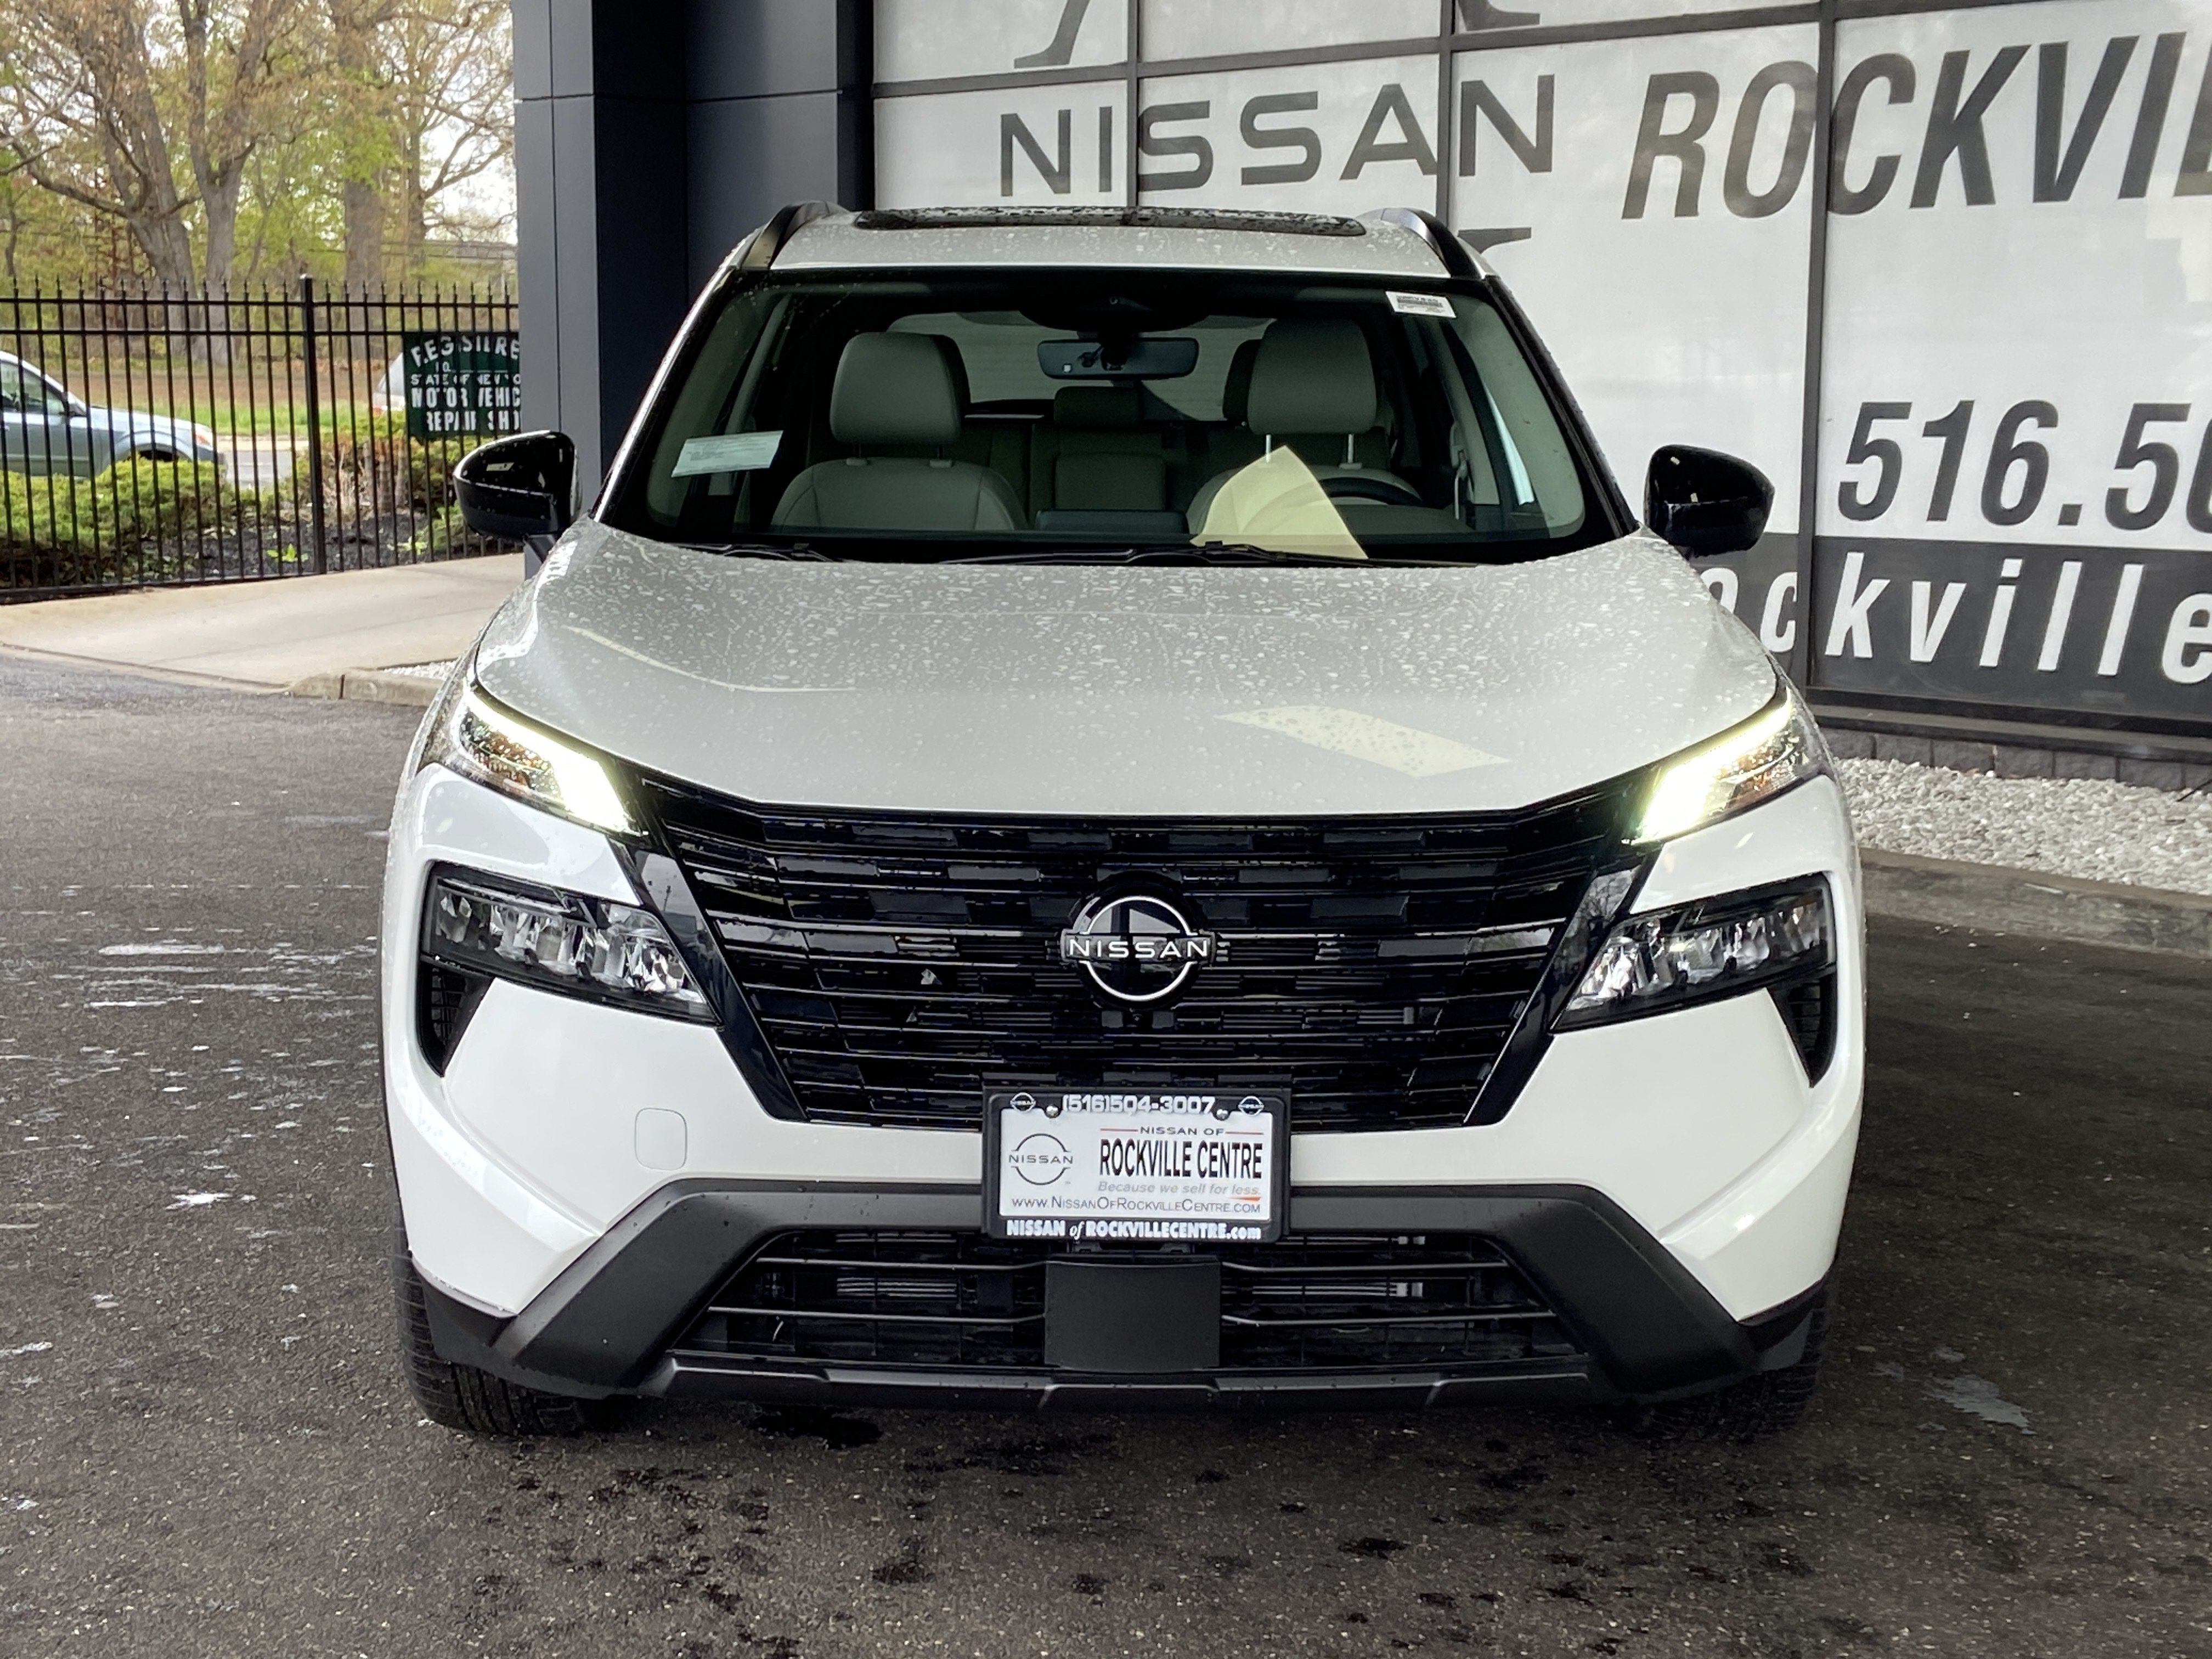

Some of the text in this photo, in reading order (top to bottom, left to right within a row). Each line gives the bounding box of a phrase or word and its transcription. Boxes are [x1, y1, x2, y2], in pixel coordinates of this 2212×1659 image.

[1000, 74, 1556, 197] NISSAN
[1069, 939, 1209, 958] NISSAN
[1062, 1094, 1216, 1115] (516)504-3007
[1140, 1126, 1224, 1136] NISSAN OF
[1008, 1154, 1074, 1164] NISSAN
[1099, 1138, 1263, 1179] ROCKVILLE CENTRE
[1098, 1181, 1261, 1195] Because we sell for less.
[1006, 1220, 1261, 1240] NISSAN of ROCKVILLECENTRE.com
